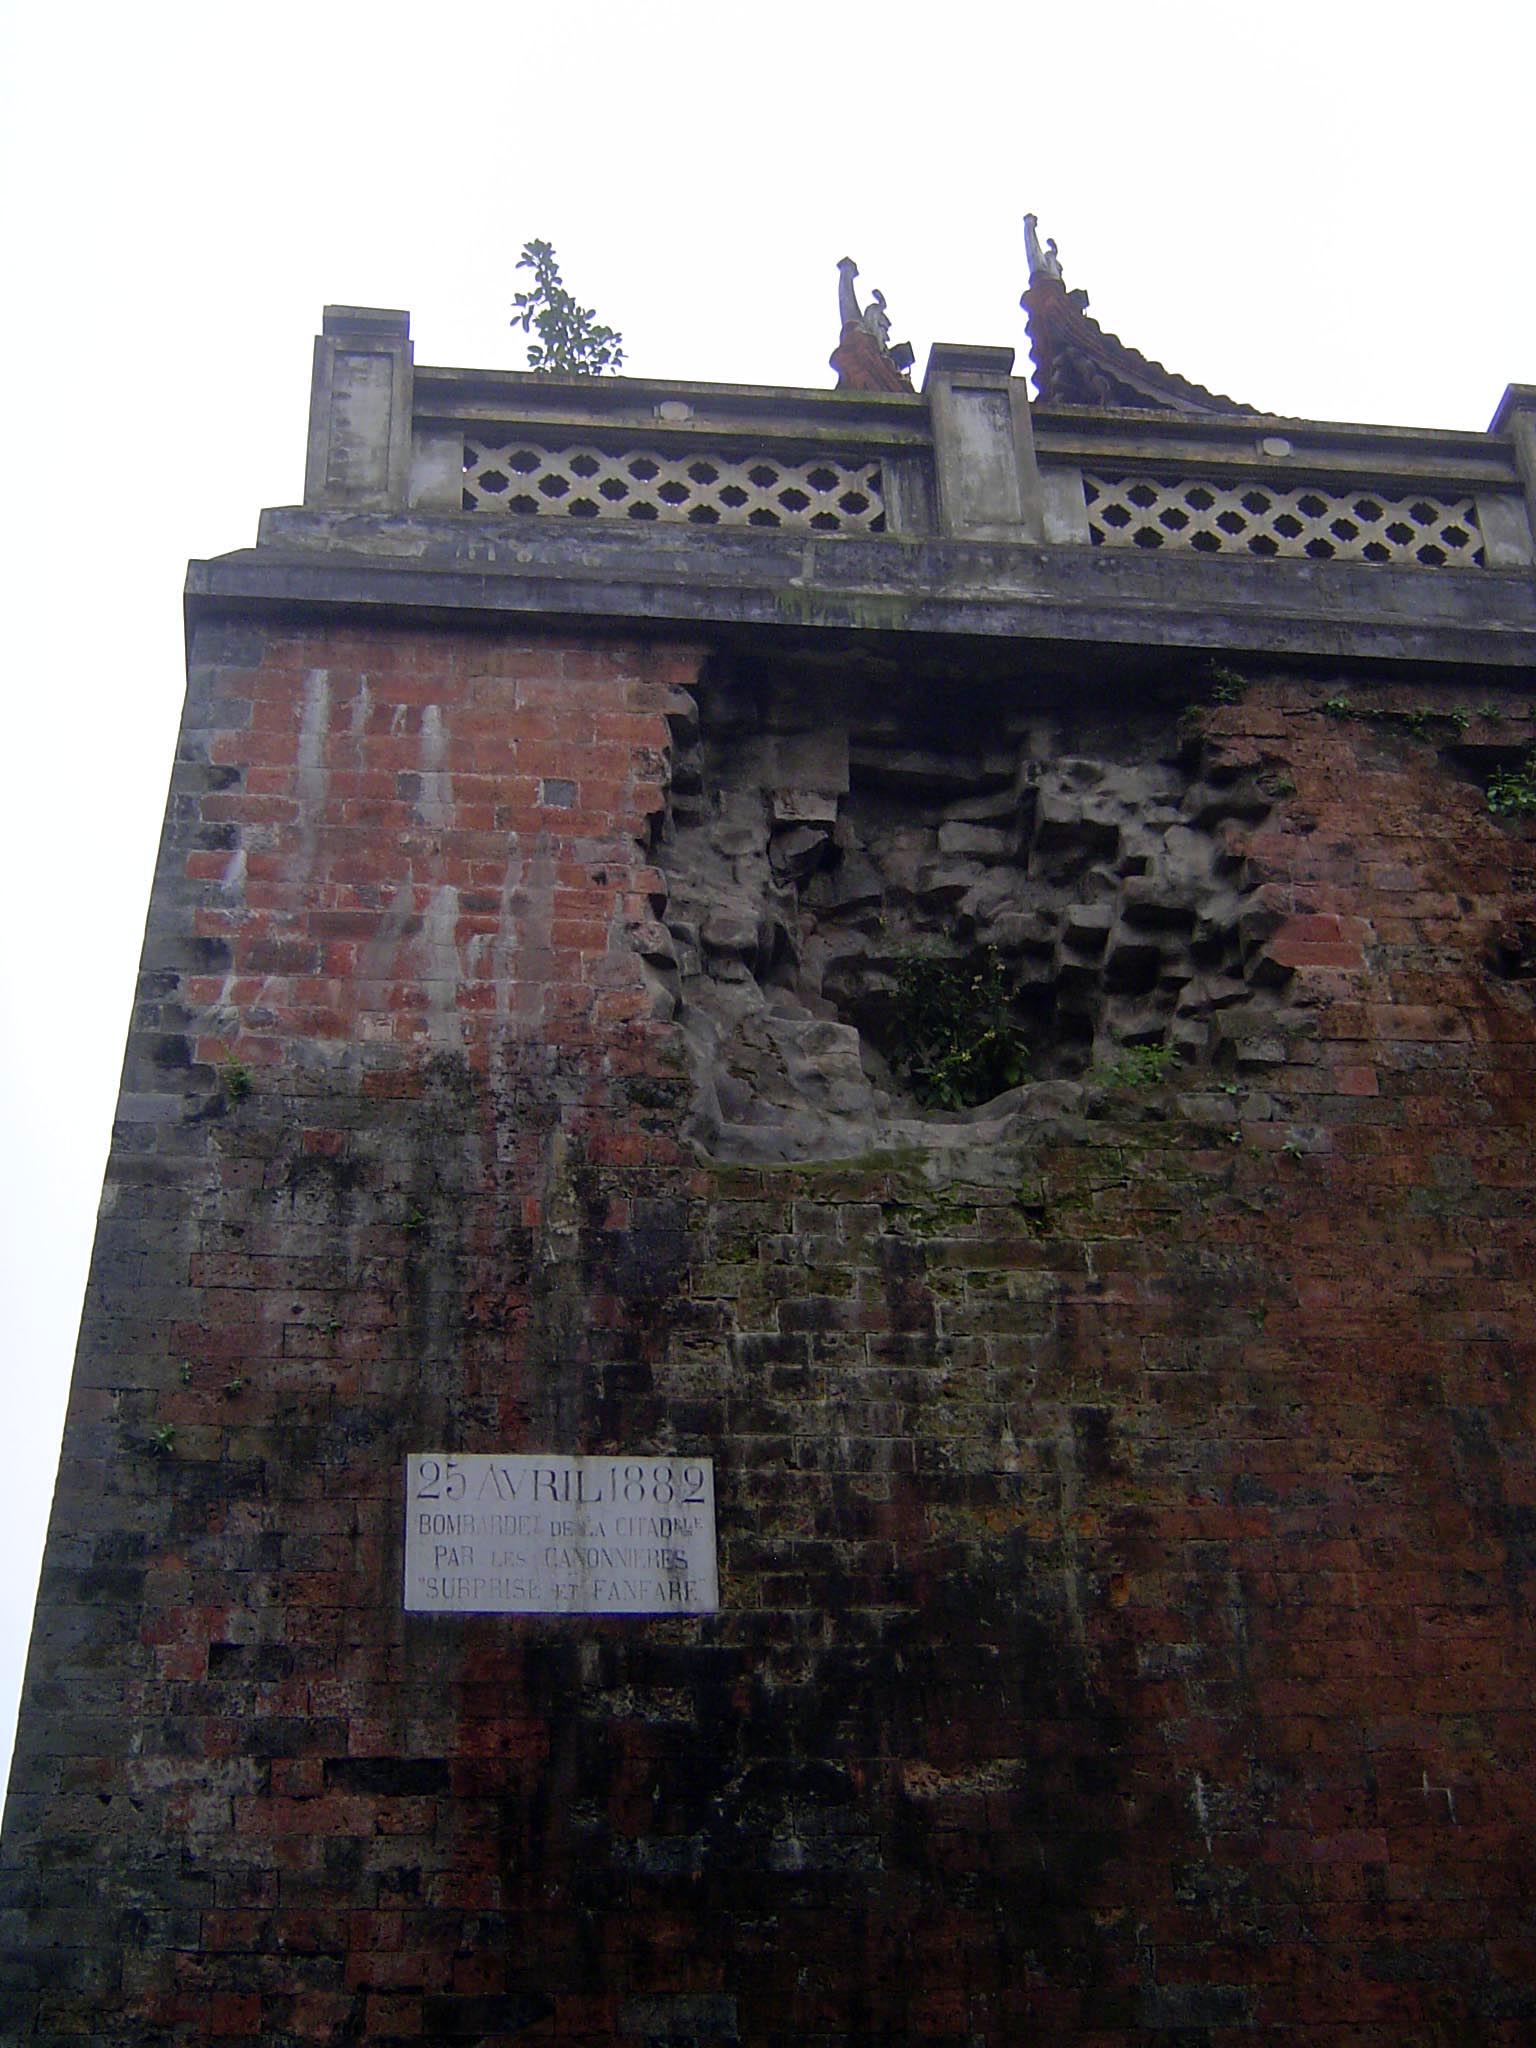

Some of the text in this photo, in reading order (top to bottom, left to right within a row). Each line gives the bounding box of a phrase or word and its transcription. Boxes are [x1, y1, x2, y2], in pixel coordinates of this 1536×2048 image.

[416, 1461, 705, 1504] 25 AVRIL 1882
[550, 1520, 574, 1537] DE
[434, 1545, 474, 1568] PAR
[490, 1551, 526, 1568] LES
[554, 1582, 579, 1601] ET
